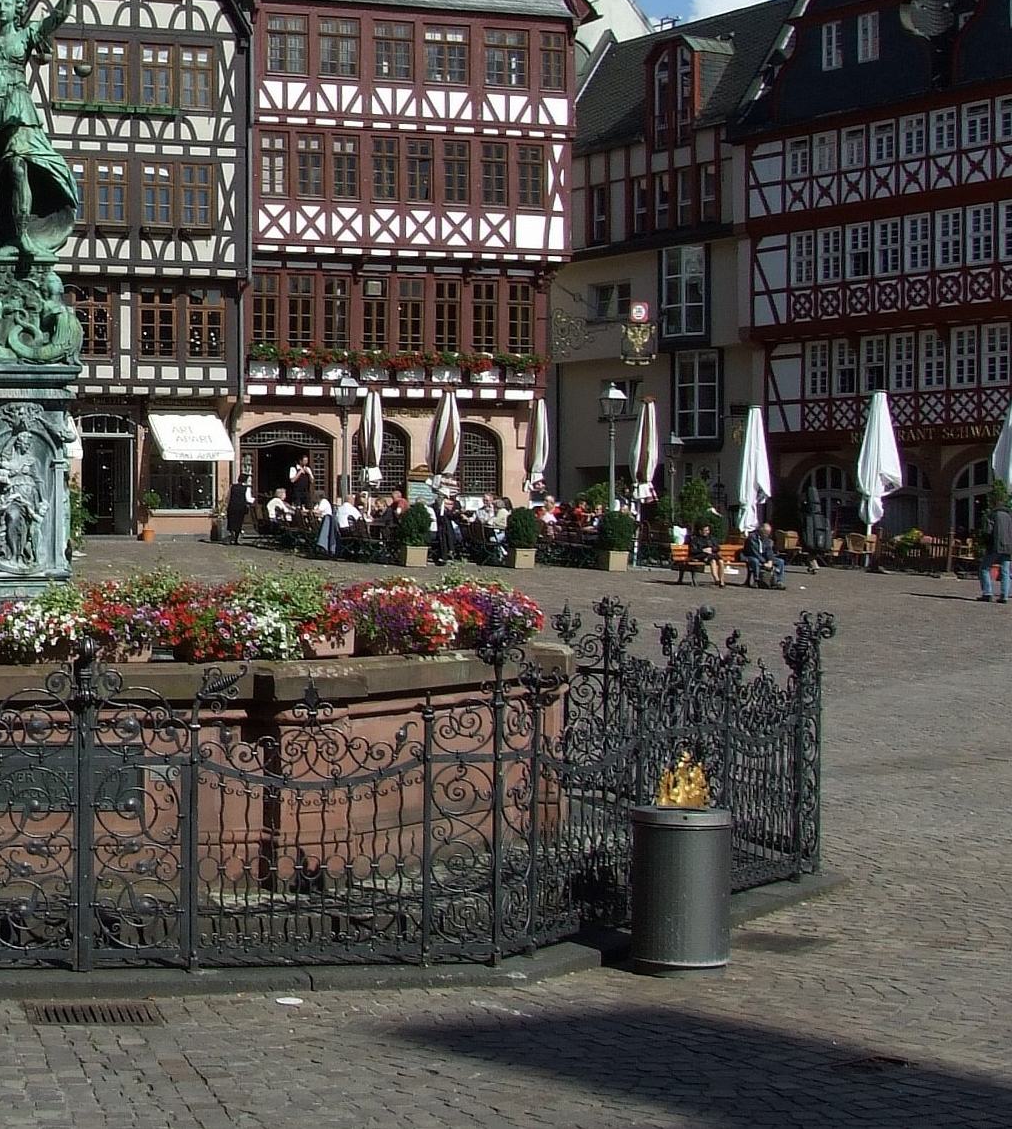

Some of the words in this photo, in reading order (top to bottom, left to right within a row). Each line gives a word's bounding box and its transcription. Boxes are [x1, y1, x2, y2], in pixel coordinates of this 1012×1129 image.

[175, 435, 213, 443] APART
[850, 427, 935, 443] RERANT
[941, 424, 1002, 439] SCHWAR
